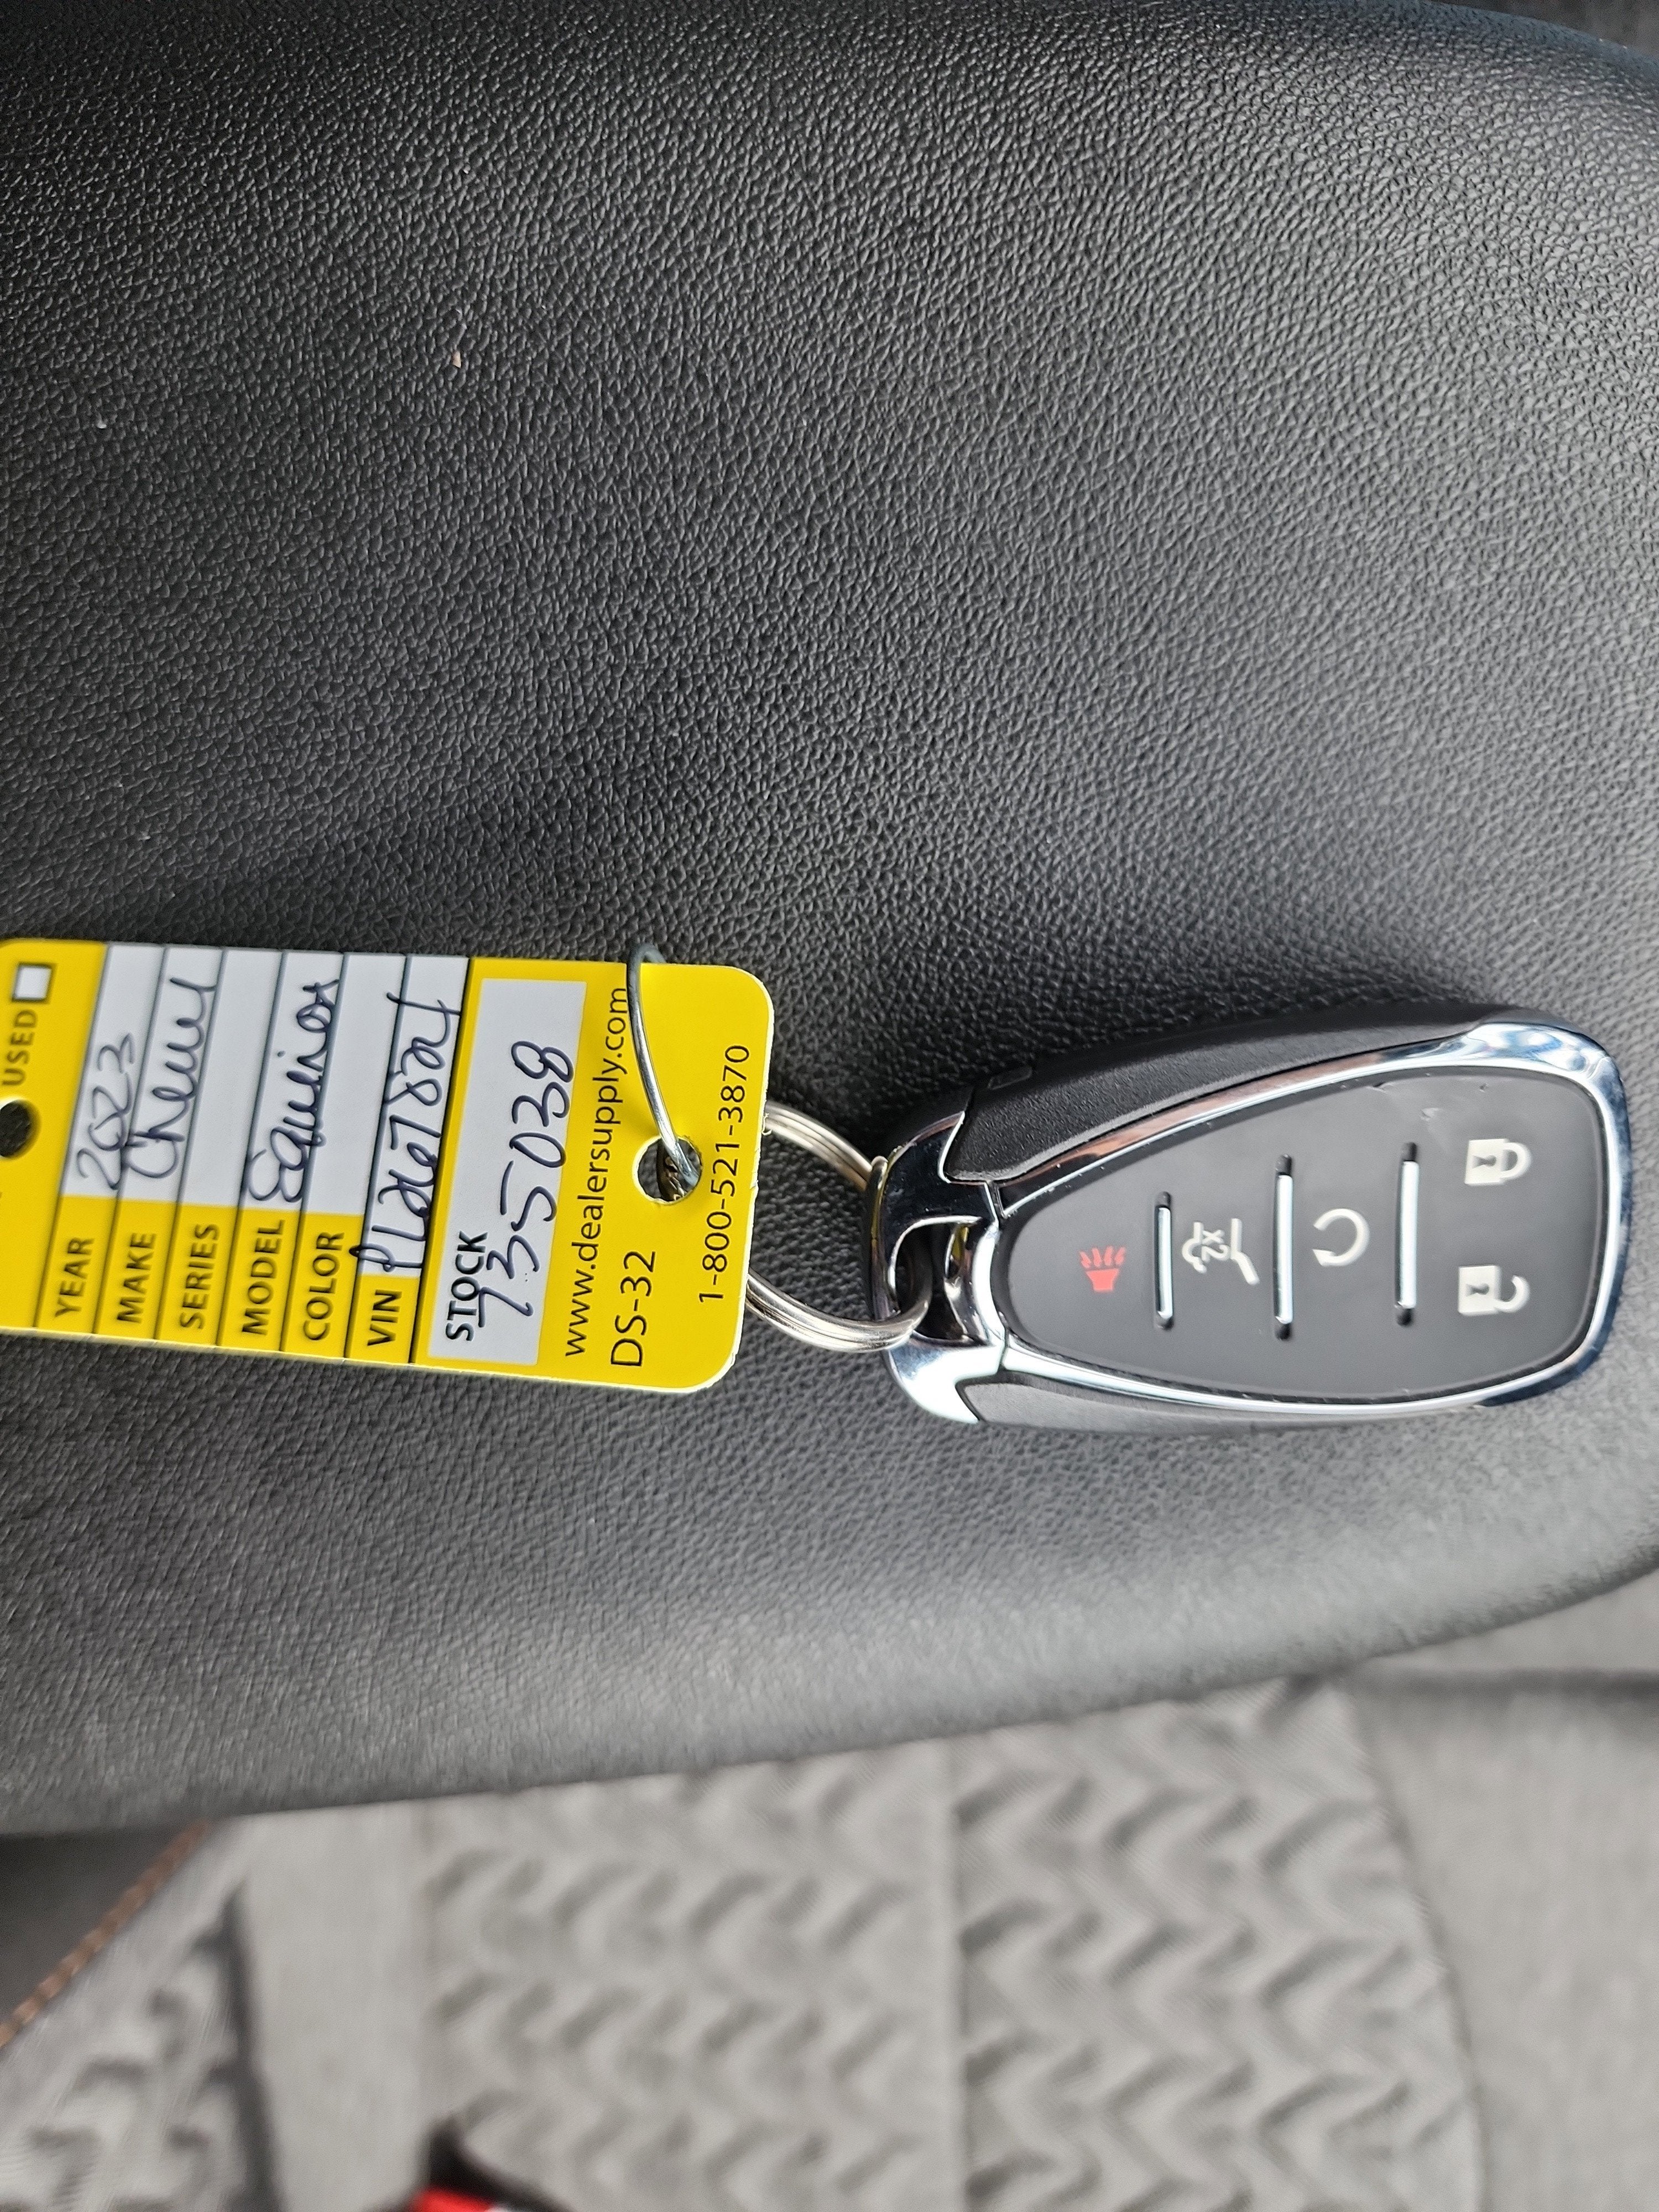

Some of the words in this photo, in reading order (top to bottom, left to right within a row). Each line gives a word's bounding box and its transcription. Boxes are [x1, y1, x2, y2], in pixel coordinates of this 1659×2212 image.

[2, 1009, 38, 1086] USED
[76, 1032, 135, 1190] 2023
[477, 1041, 574, 1328] 735038
[565, 988, 628, 1357] www.dealersupply.com
[699, 1045, 749, 1303] 1-800-521-3870
[55, 1237, 95, 1318] YEAR
[116, 1232, 157, 1324] MAKE
[179, 1223, 221, 1330] SERIES
[242, 1219, 285, 1335] MODEL
[303, 1232, 344, 1340] COLOR
[367, 1289, 402, 1346] VIN
[445, 1230, 488, 1342] STOCK
[611, 1250, 656, 1367] DS-32
